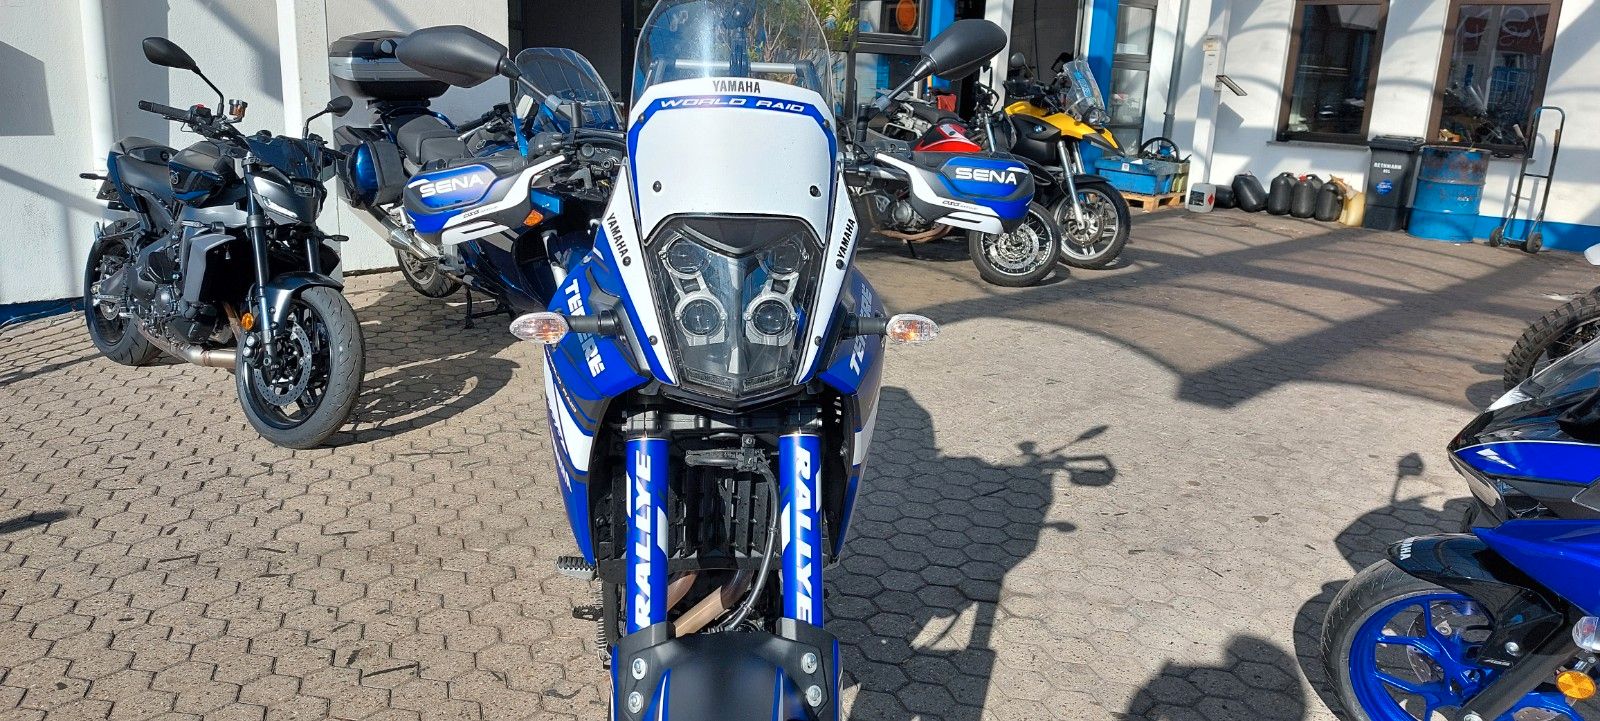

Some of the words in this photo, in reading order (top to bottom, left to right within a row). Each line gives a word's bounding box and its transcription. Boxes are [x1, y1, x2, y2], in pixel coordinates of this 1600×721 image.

[713, 80, 761, 94] YAMAHA
[661, 98, 746, 108] WORLD
[756, 101, 805, 112] RAID
[419, 174, 484, 198] SENA
[955, 167, 1018, 185] SENA
[607, 212, 629, 258] YAMAHA
[836, 218, 856, 259] YAMAHA
[634, 450, 652, 630] RALLYE
[796, 446, 813, 624] RALLYE
